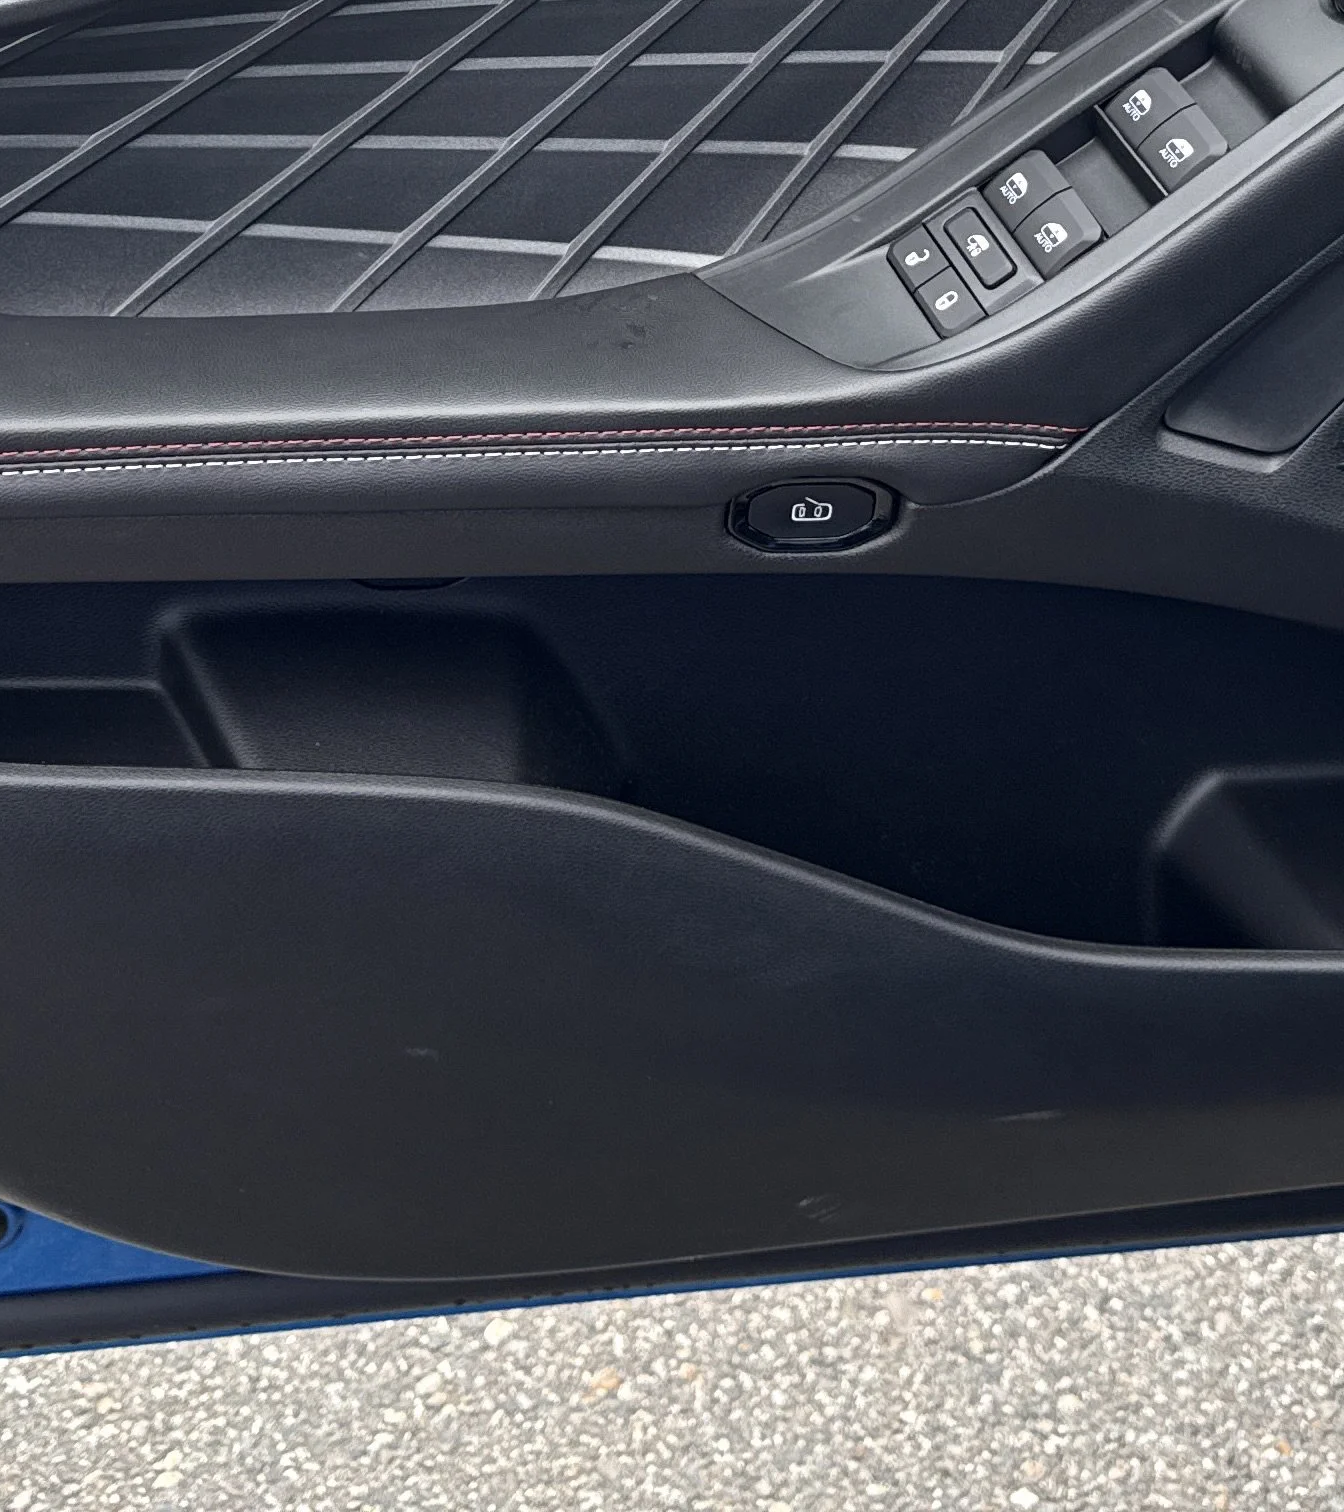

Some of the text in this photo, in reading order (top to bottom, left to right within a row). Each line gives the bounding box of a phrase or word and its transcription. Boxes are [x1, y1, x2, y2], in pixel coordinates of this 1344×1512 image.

[1122, 102, 1141, 122] AUTO
[1158, 148, 1178, 169] AUTO
[999, 185, 1017, 205] AUTO
[1033, 232, 1053, 253] AUTO
